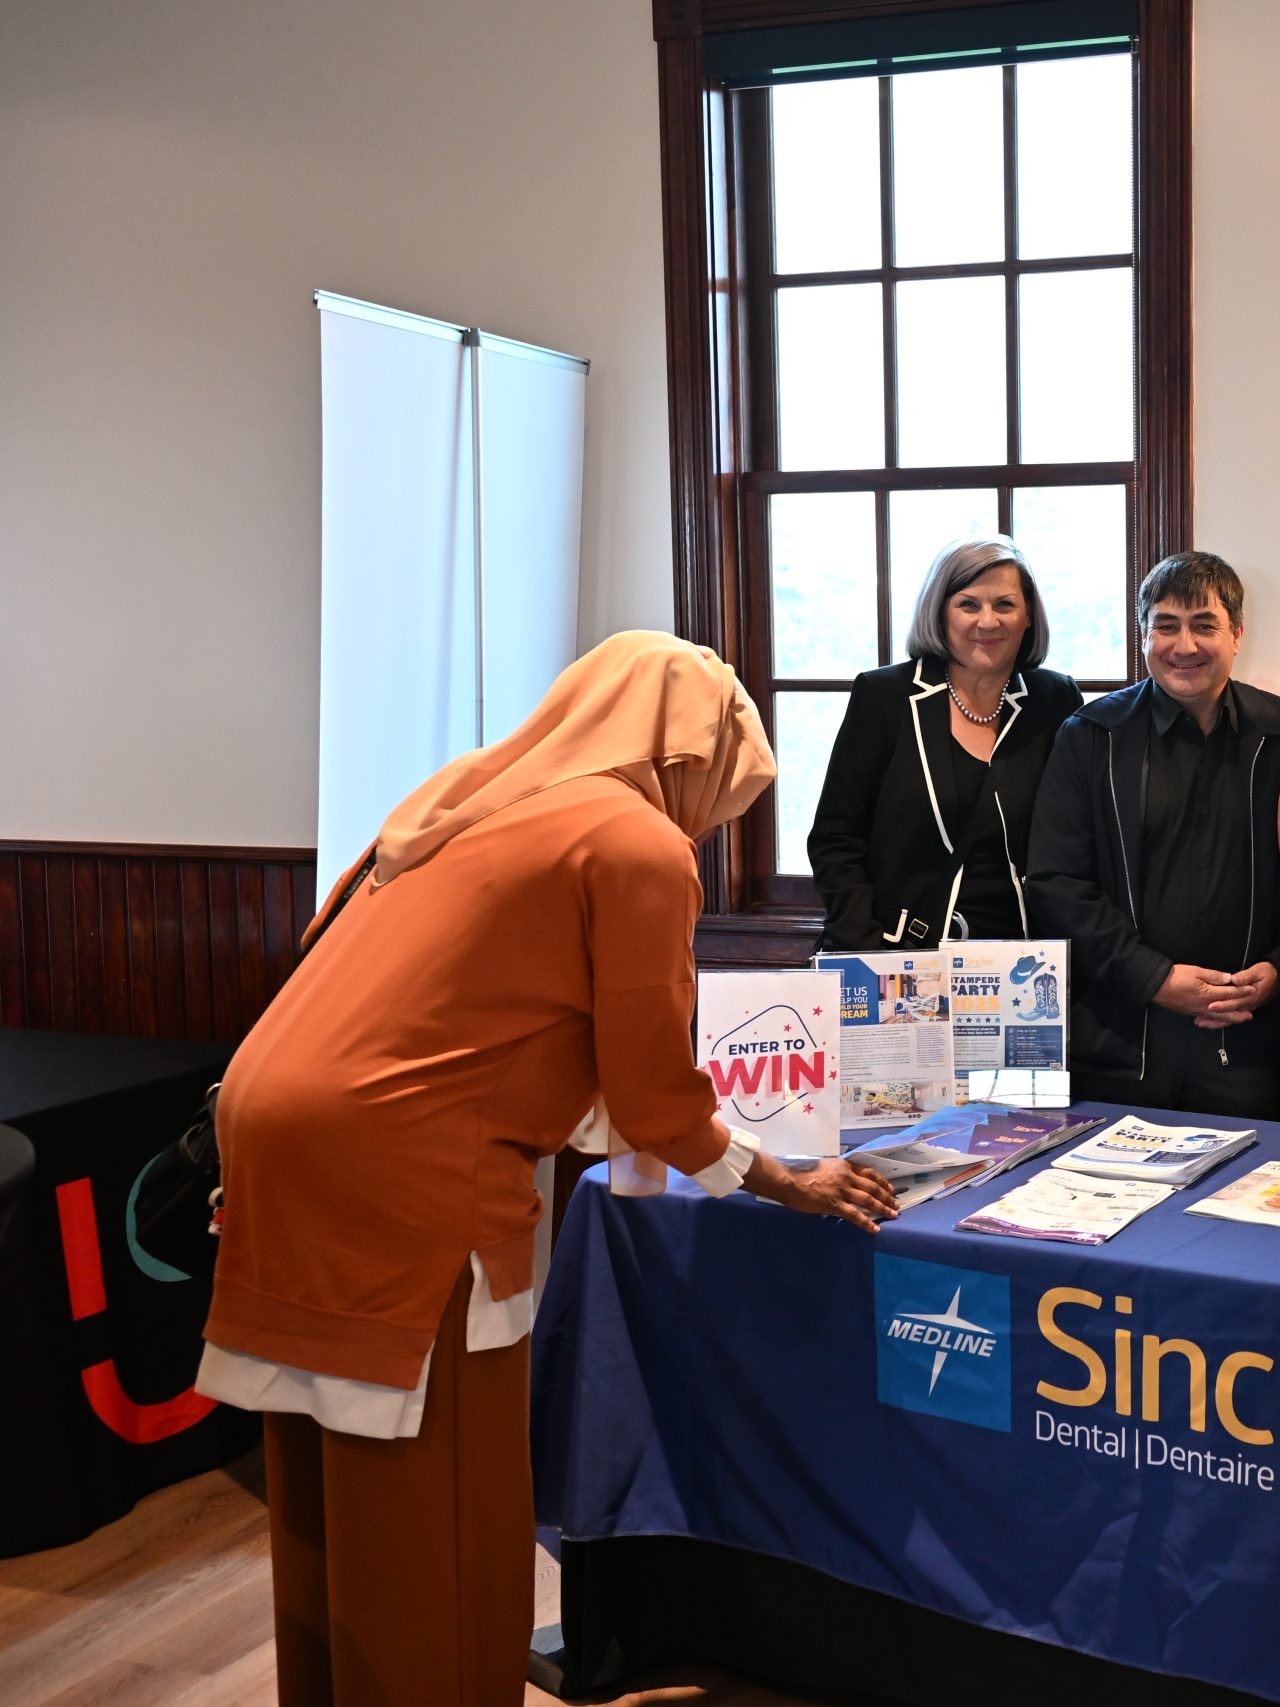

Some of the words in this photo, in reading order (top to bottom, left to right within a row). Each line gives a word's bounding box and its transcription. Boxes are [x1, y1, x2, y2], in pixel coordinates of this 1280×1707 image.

[840, 987, 852, 997] ET
[854, 986, 868, 996] US
[853, 996, 868, 1004] YOU
[840, 1010, 869, 1018] REAM
[728, 1041, 780, 1055] ENTER
[784, 1039, 805, 1051] TO
[708, 1051, 825, 1097] WIN
[887, 1319, 997, 1359] MEDLINE
